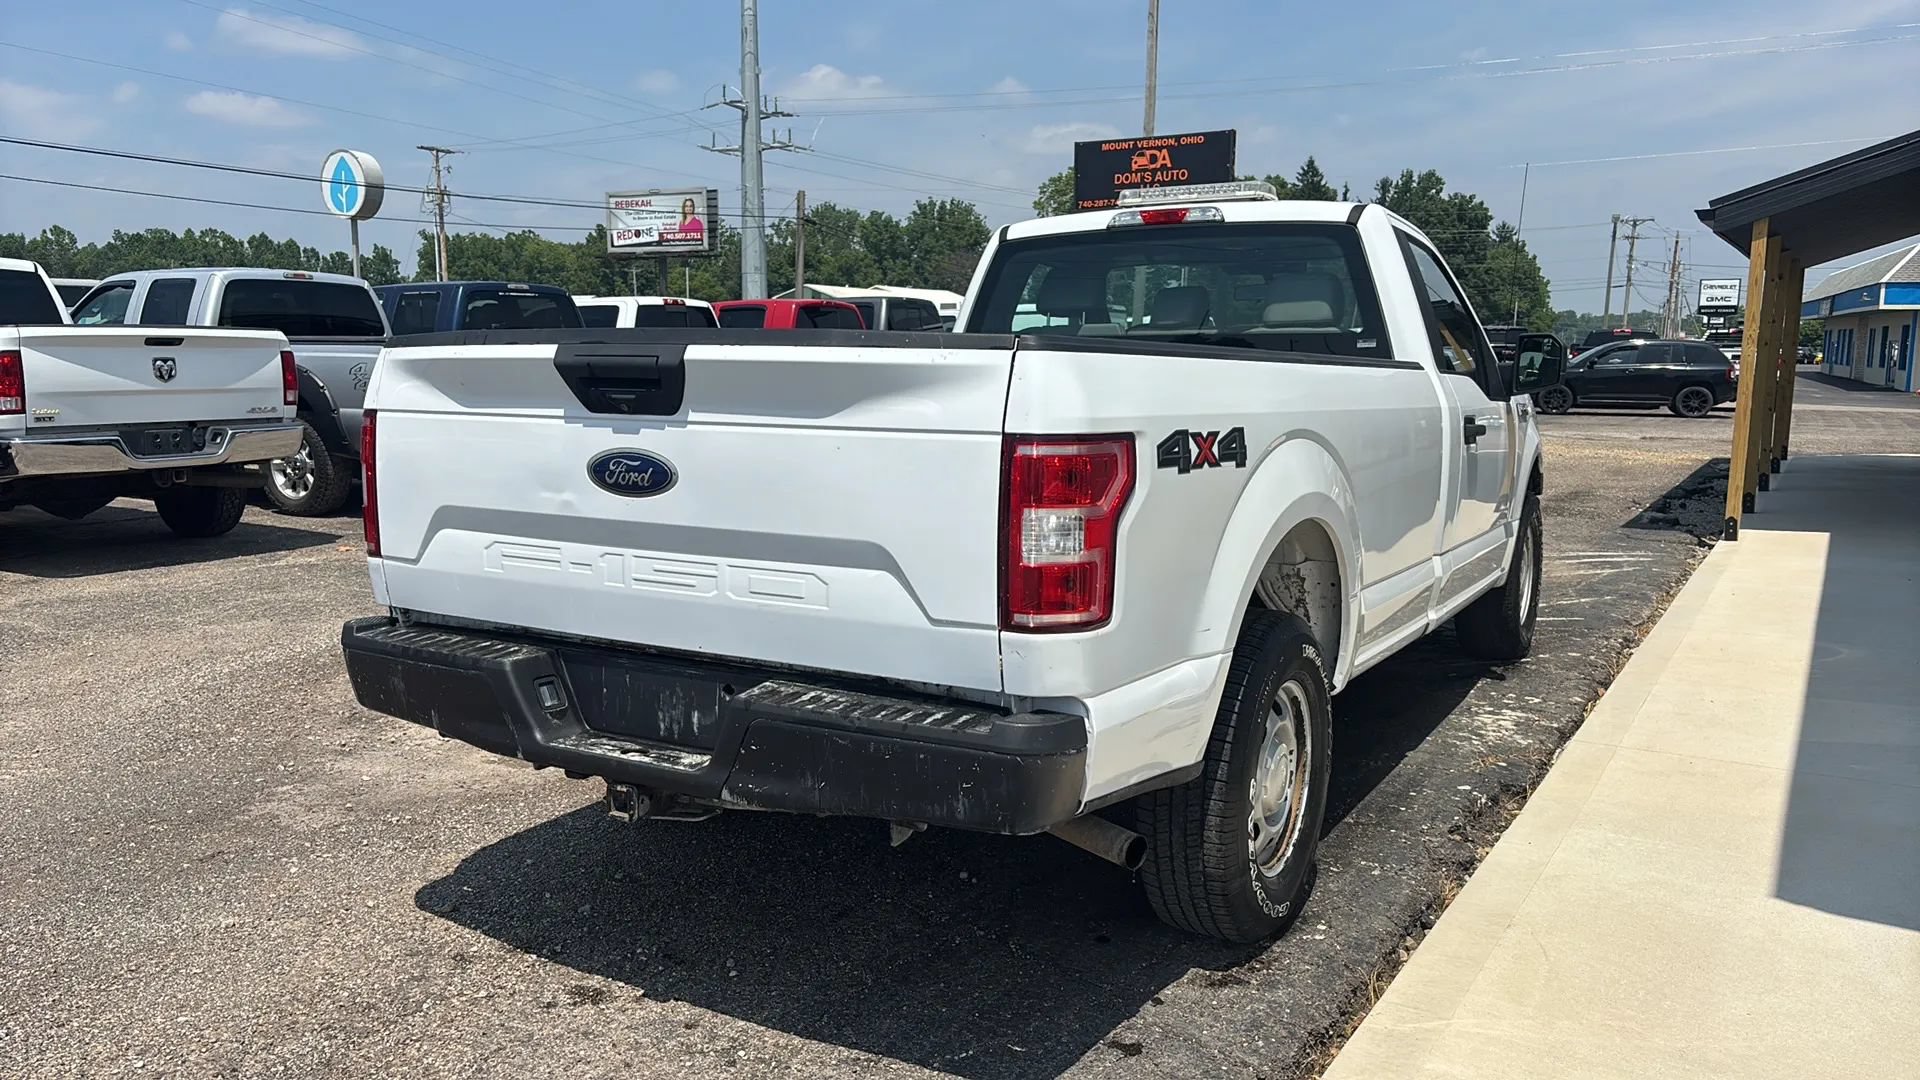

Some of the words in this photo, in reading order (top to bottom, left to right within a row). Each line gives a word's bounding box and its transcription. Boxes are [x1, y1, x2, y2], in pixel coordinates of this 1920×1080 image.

[1101, 140, 1134, 150] MOUNT
[1136, 138, 1178, 148] VERNON,
[1180, 135, 1205, 144] OHIO
[1114, 172, 1152, 185] DOM'S
[1154, 169, 1189, 181] AUTO
[614, 199, 652, 209] REBEKAH
[604, 458, 654, 487] Ford
[484, 540, 829, 610] F-150
